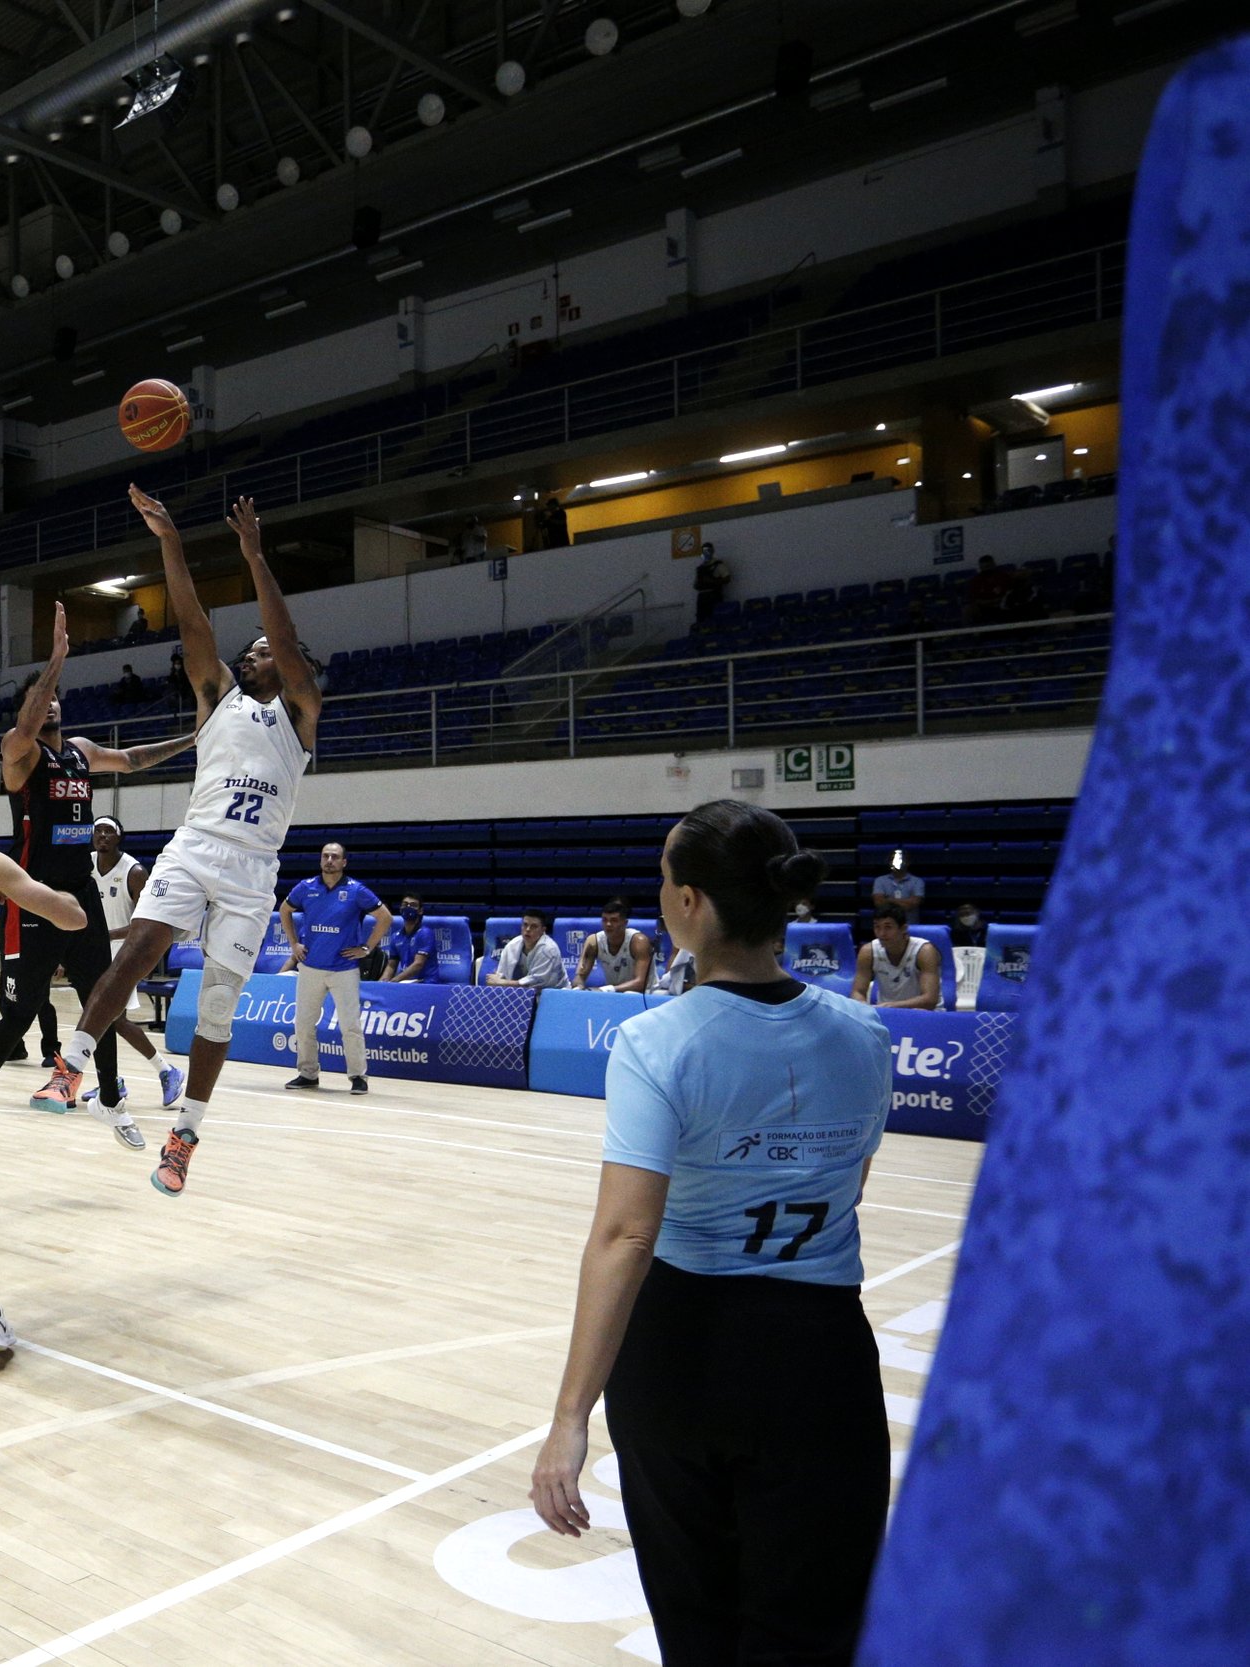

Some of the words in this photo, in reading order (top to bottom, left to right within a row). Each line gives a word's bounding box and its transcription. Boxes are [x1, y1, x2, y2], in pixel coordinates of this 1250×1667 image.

[943, 529, 961, 548] G
[787, 748, 809, 772] C
[829, 746, 852, 769] D
[224, 774, 278, 796] minas
[72, 803, 81, 822] 9
[225, 792, 263, 825] 22
[311, 924, 340, 933] minas
[792, 958, 840, 970] MINAS
[328, 1000, 435, 1038] inas!
[767, 1131, 814, 1141] FORMAÇÃO
[828, 1128, 858, 1139] ATLETAS
[767, 1146, 798, 1160] CBC
[742, 1200, 829, 1261] 17
